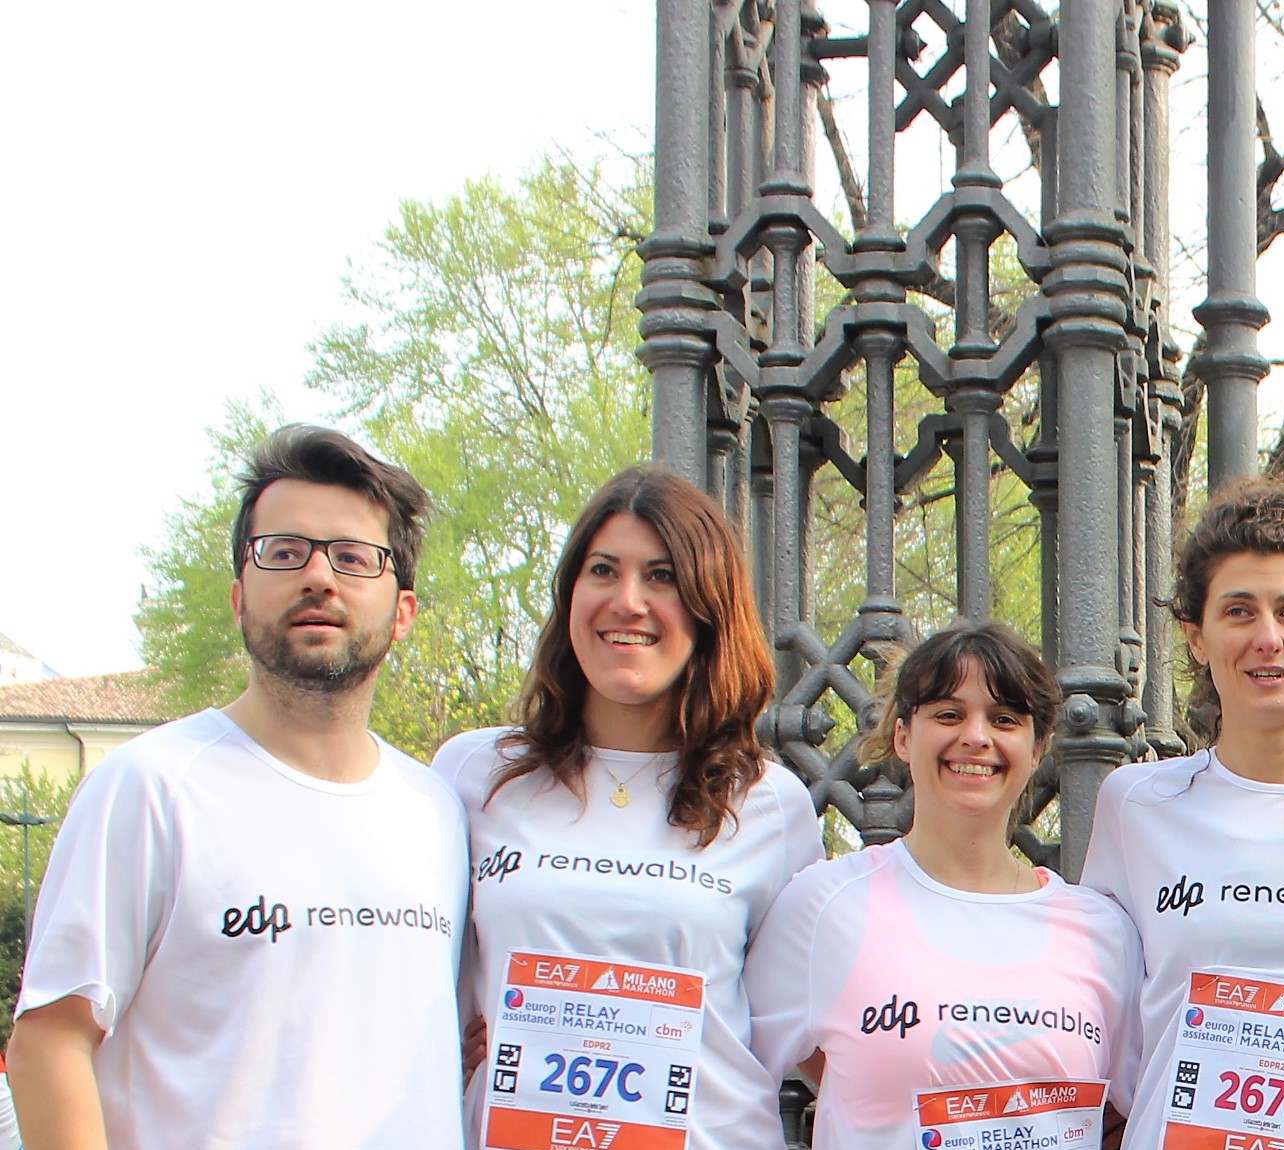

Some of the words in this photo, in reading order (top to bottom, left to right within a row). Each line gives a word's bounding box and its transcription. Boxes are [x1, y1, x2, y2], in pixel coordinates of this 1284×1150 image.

[478, 845, 523, 883] edp
[538, 852, 733, 895] renewables
[1156, 875, 1203, 916] edp
[222, 896, 293, 942] edp
[306, 902, 452, 937] renewables
[535, 961, 580, 983] EA7
[623, 972, 676, 990] MILANO
[623, 984, 675, 997] MARATHON
[1215, 981, 1259, 1003] EA7
[525, 1002, 556, 1014] europ
[564, 1003, 621, 1020] RELAY
[861, 994, 920, 1039] edp
[938, 1003, 1100, 1044] renewables
[502, 1012, 555, 1025] assistance
[562, 1017, 647, 1036] MARATHON
[655, 1024, 682, 1038] cbm
[1182, 1030, 1233, 1044] assistance
[1205, 1021, 1235, 1034] europ
[583, 1040, 611, 1050] EDPR2
[539, 1053, 646, 1103] 267C
[946, 1094, 988, 1115] EA7
[1030, 1087, 1077, 1099] MILANO
[1030, 1096, 1076, 1108] MARATHON
[551, 1118, 621, 1149] EA7
[945, 1136, 975, 1149] europ
[981, 1126, 1034, 1143] RELAY
[1064, 1127, 1084, 1140] cbm
